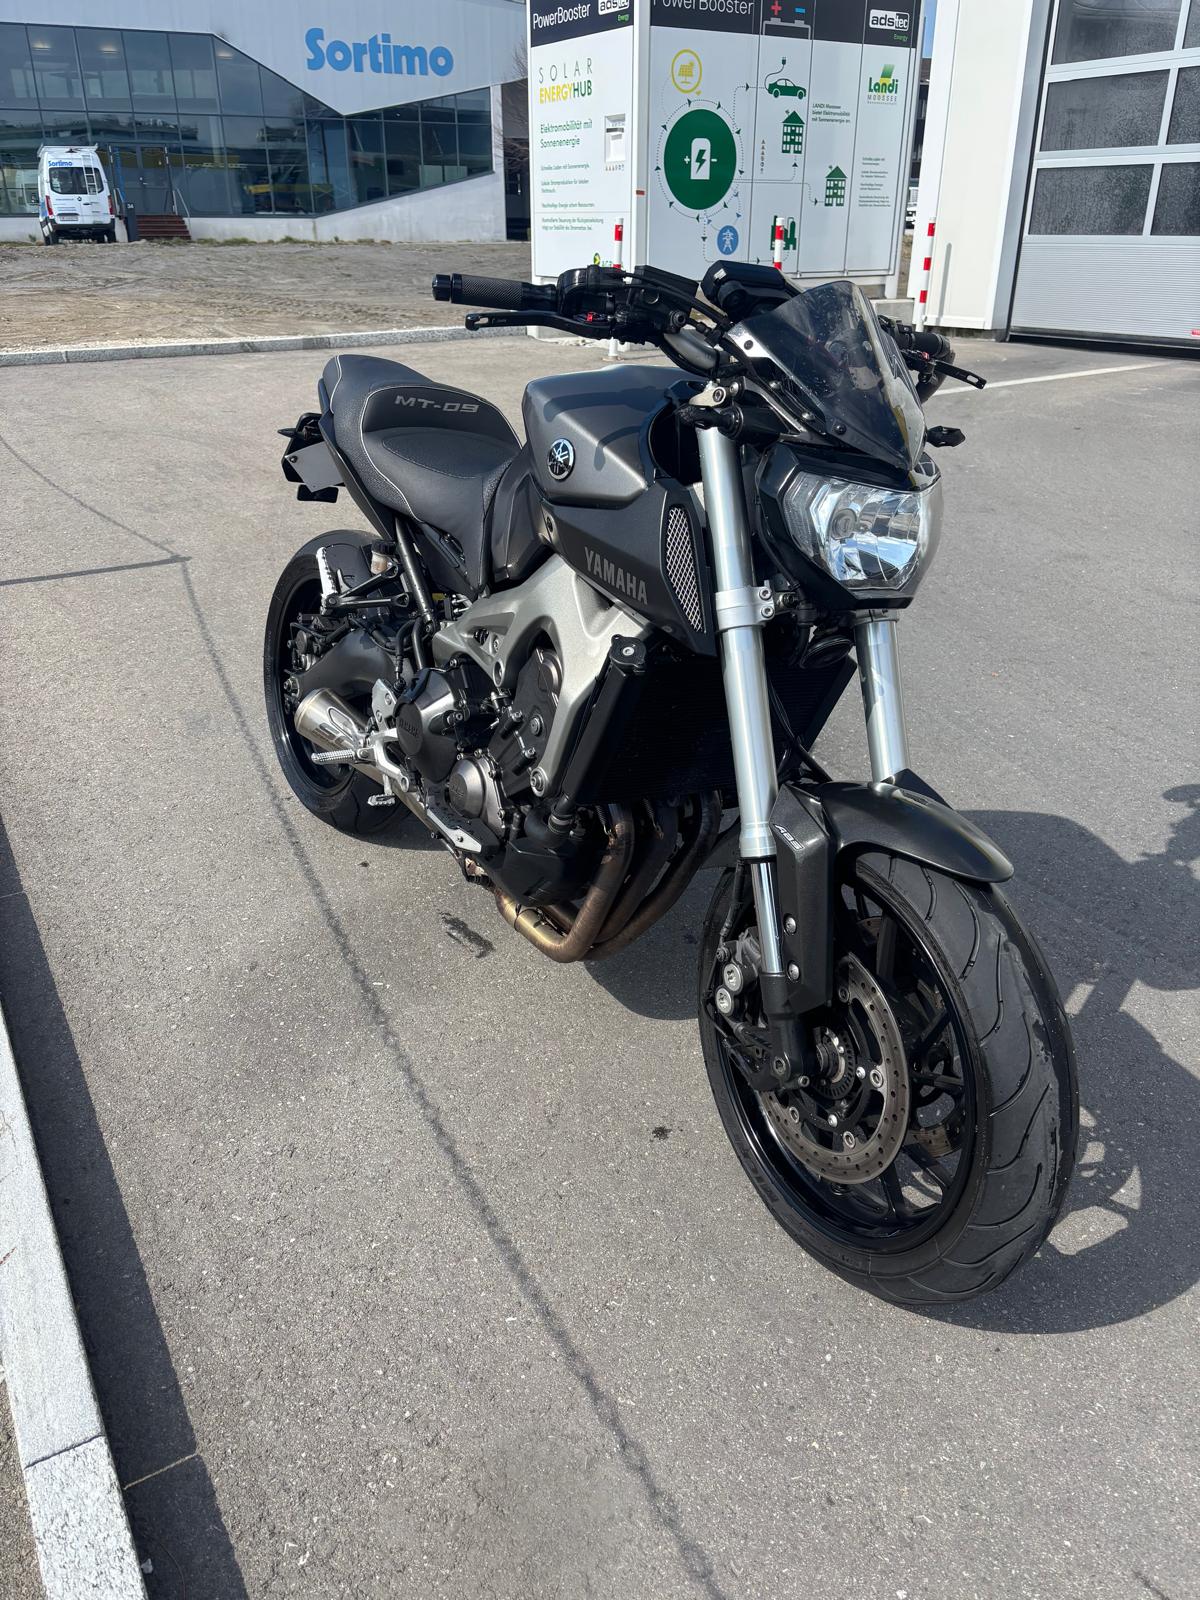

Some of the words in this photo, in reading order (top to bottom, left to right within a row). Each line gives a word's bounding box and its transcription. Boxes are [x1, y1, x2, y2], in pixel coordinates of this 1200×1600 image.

[533, 3, 591, 30] PowerBooster
[871, 13, 909, 29] adstec
[305, 27, 454, 77] Sortimo
[539, 58, 593, 84] SOLAR
[539, 79, 593, 105] ENERGYHUB
[868, 77, 899, 94] Landi
[540, 120, 582, 134] Elektromobilität
[583, 118, 593, 129] mit
[540, 135, 580, 149] Sonnenenergie
[395, 395, 480, 413] MT-09
[584, 546, 648, 605] YAMAHA
[774, 823, 806, 850] ABS
